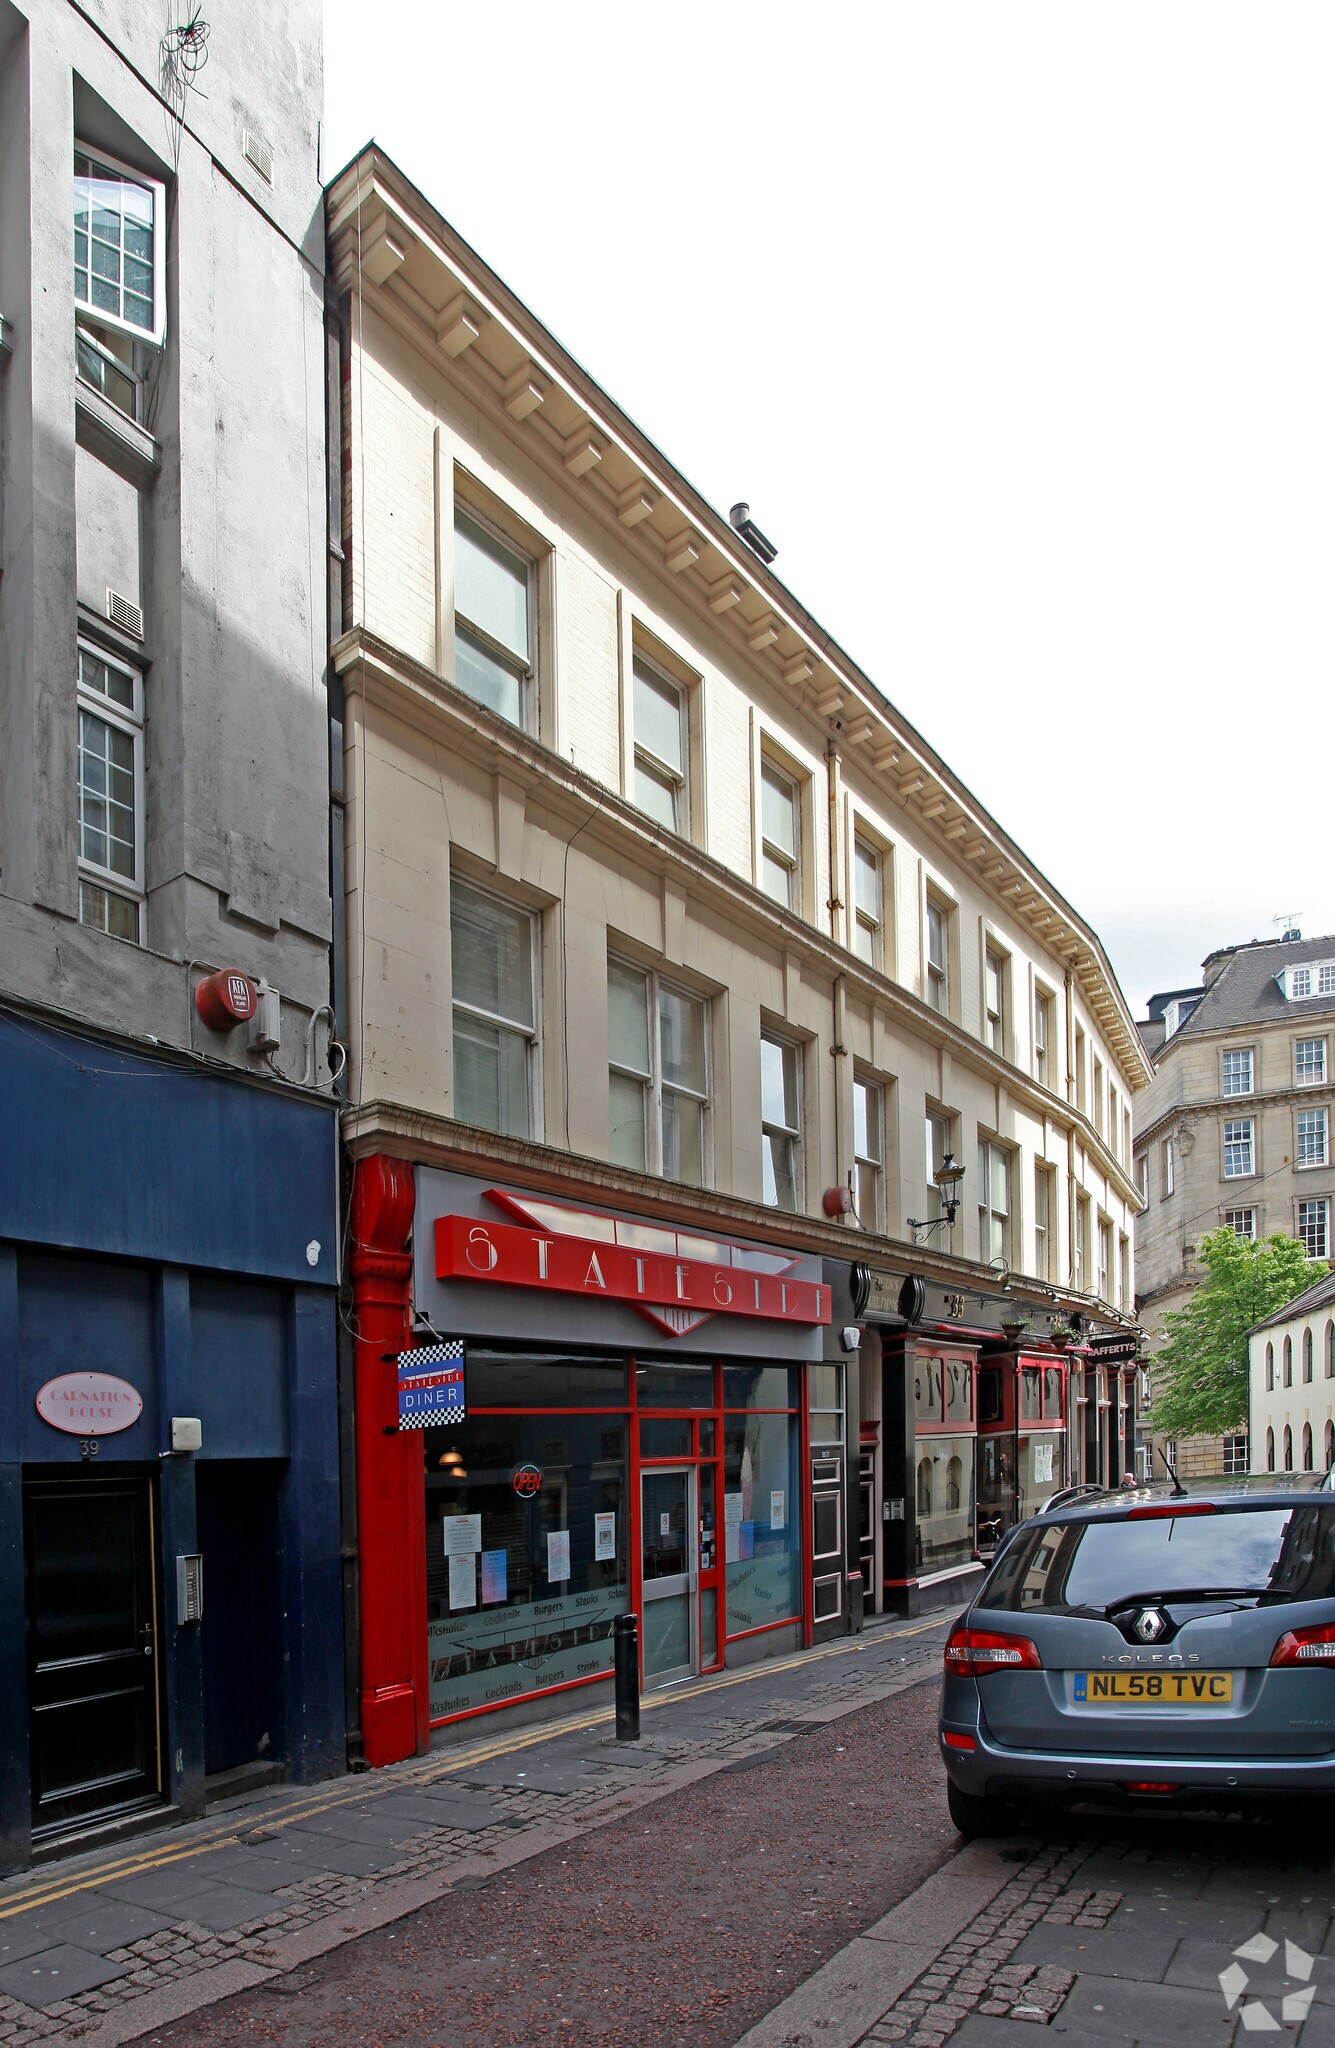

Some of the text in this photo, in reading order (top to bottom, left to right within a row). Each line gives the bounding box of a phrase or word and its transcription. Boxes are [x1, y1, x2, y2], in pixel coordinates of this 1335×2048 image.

[466, 1226, 828, 1318] STATESIDE
[402, 1373, 460, 1390] STATESIDE
[50, 1390, 131, 1403] CARNATION
[405, 1388, 457, 1408] DINER
[69, 1407, 115, 1418] HOUSE
[79, 1440, 99, 1456] 39
[513, 1472, 542, 1491] OPEN
[484, 1609, 521, 1627] Cocktails
[534, 1602, 563, 1617] Burgers
[575, 1593, 599, 1607] Steaks
[1102, 1653, 1201, 1664] KOLEOS
[485, 1681, 522, 1700] Cocktails
[535, 1669, 564, 1686] Burgers
[576, 1659, 600, 1674] Steaks
[1092, 1675, 1226, 1697] NL58 TVC
